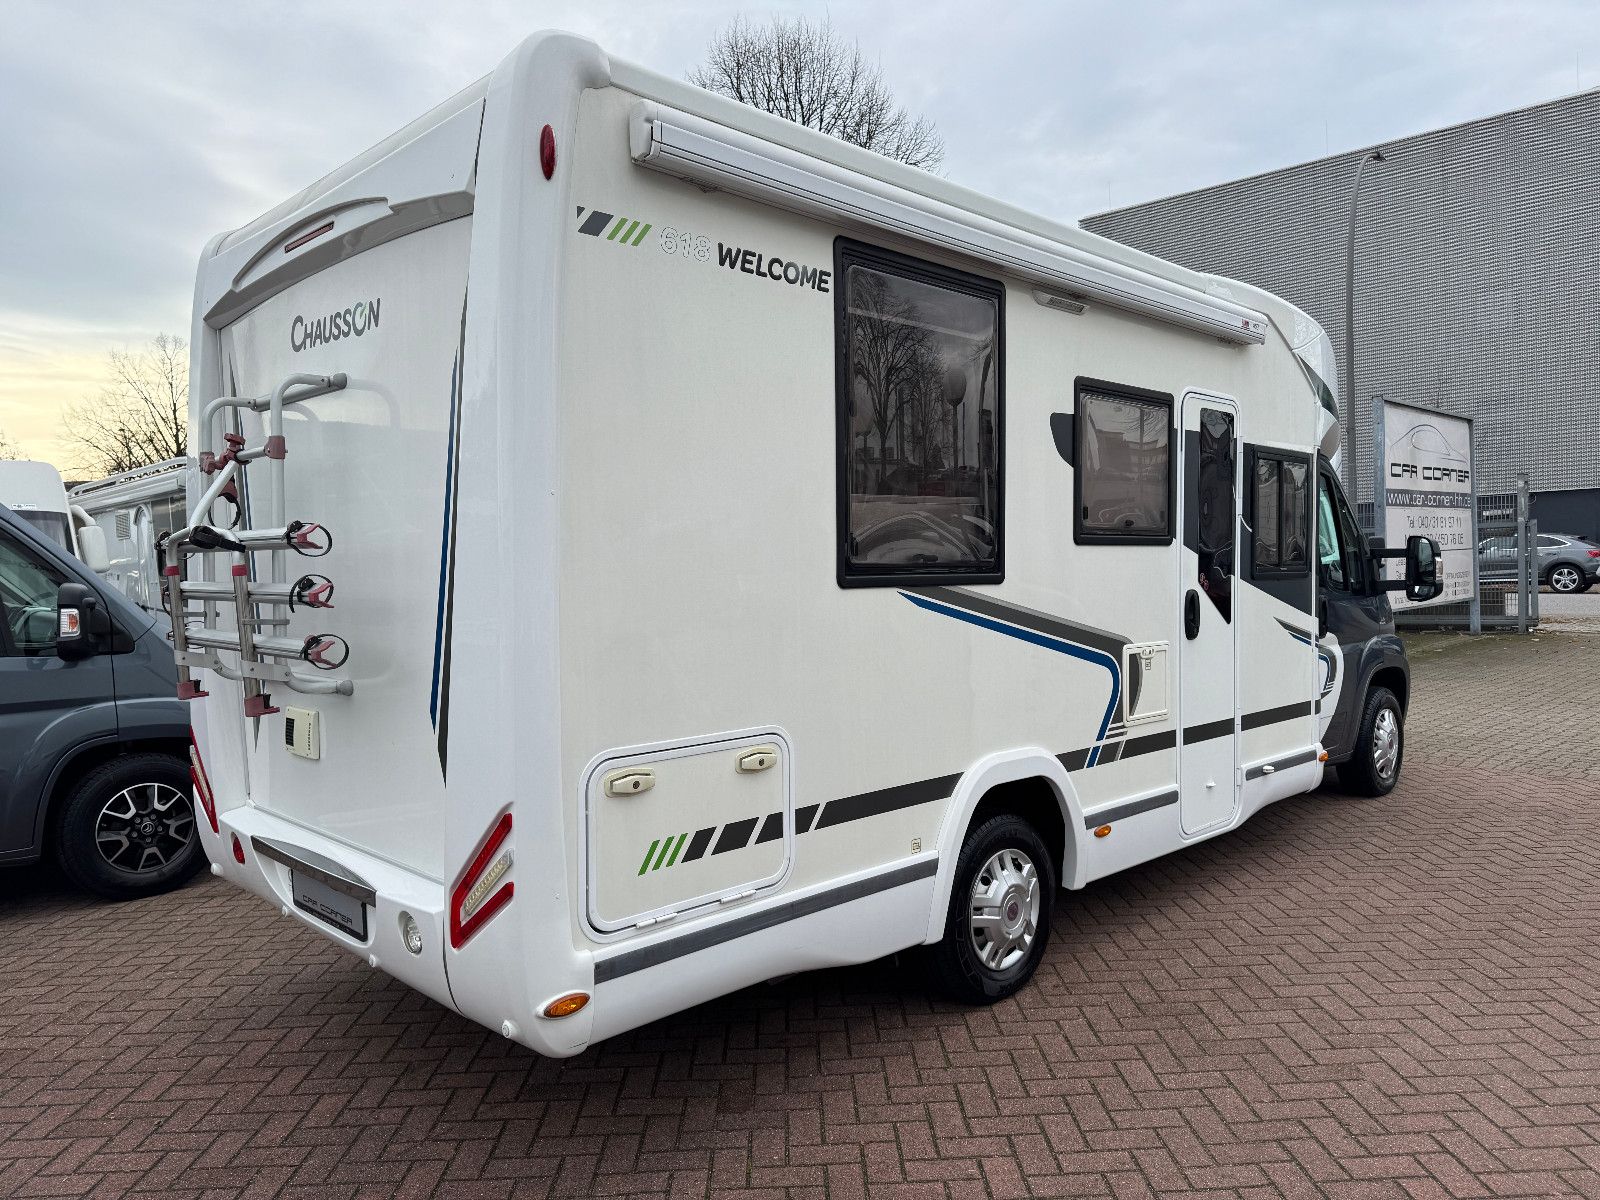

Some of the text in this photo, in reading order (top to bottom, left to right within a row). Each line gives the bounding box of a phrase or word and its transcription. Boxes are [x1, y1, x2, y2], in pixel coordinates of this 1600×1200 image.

[660, 226, 832, 293] 618 WELCOME
[290, 297, 381, 353] CHAUSSON
[1390, 463, 1470, 483] CAR CORNER
